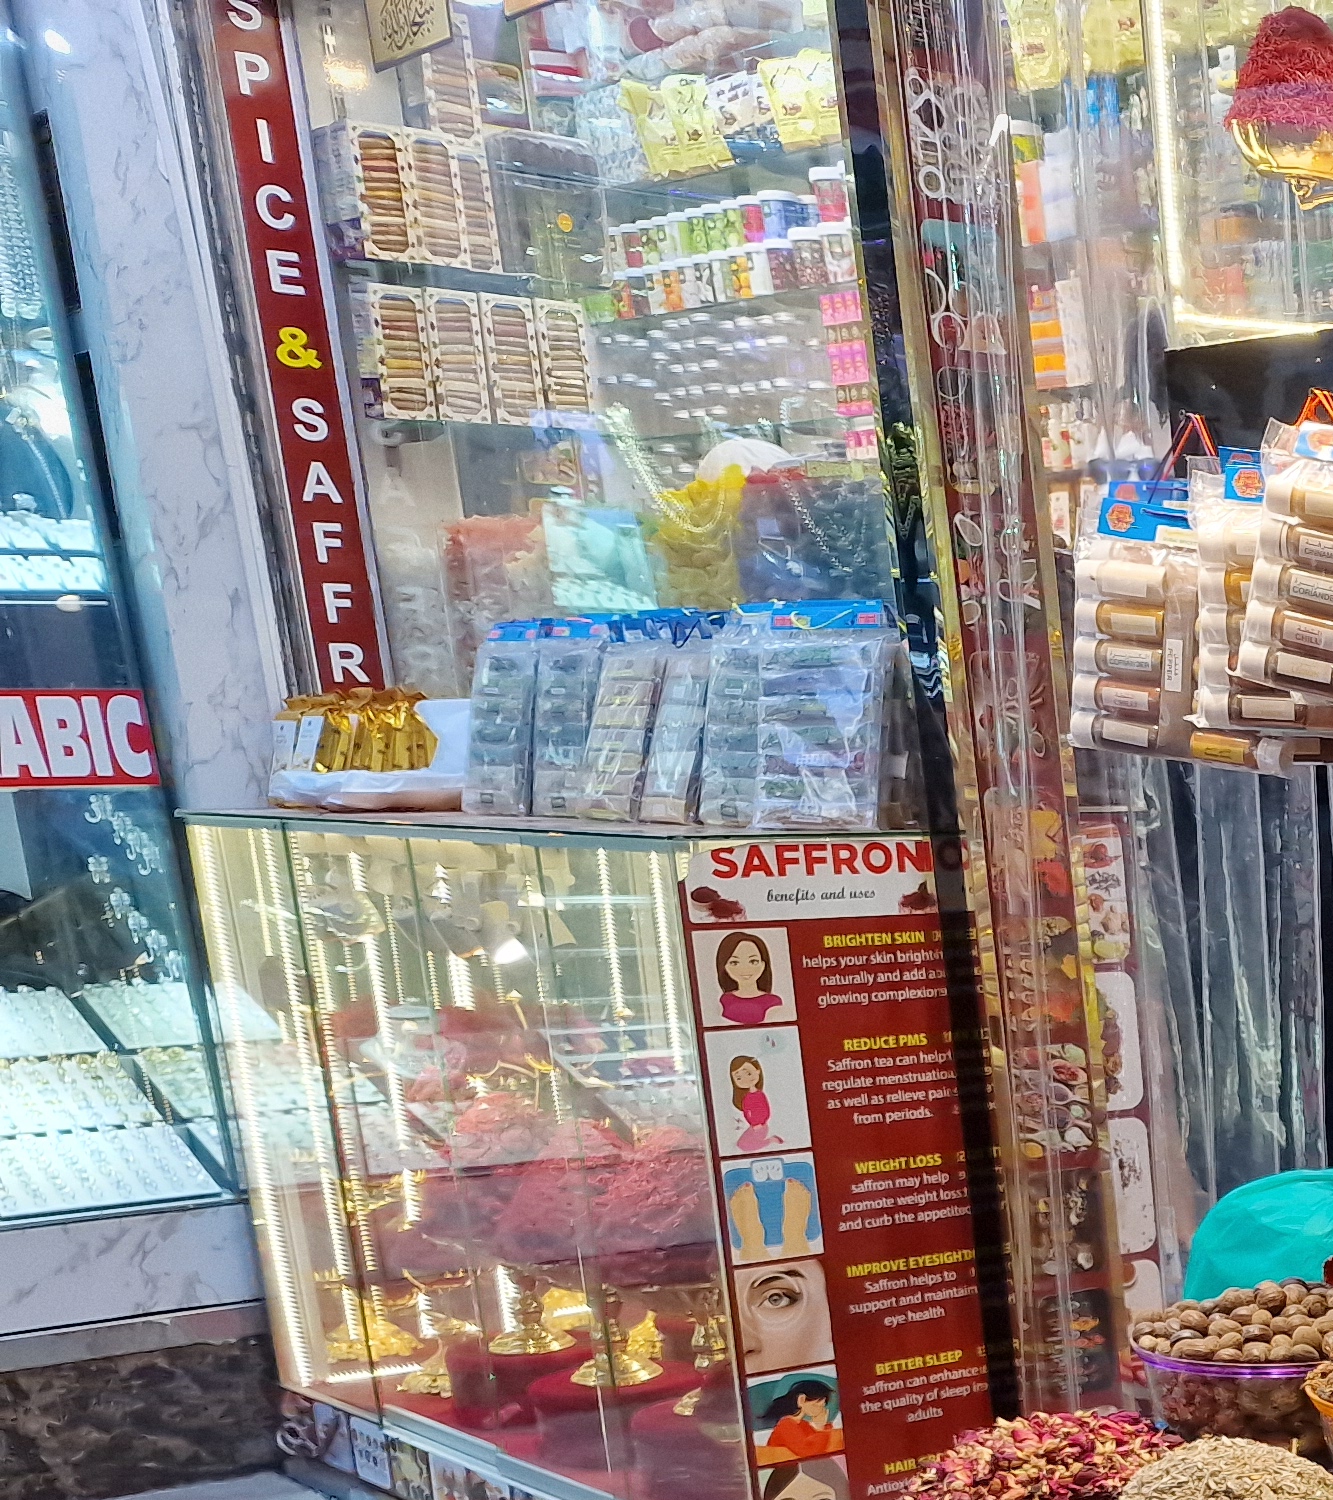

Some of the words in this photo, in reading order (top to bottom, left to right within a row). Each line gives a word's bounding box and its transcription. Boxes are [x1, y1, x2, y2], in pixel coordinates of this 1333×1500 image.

[226, 0, 306, 296] SPICE
[276, 327, 322, 370] &
[711, 842, 930, 879] SAFFRON
[766, 886, 816, 905] benefits
[820, 888, 846, 900] and
[849, 888, 876, 900] uses
[823, 932, 891, 948] BRIGHTEN
[894, 931, 925, 944] SKIN
[801, 955, 838, 970] helps
[839, 956, 869, 969] your
[870, 951, 895, 965] skin
[820, 970, 874, 986] naturally
[877, 970, 901, 983] and
[902, 966, 927, 981] add
[817, 992, 869, 1008] glowing
[843, 1036, 897, 1051] REDUCE
[899, 1033, 928, 1046] PMS
[827, 1058, 872, 1073] Saffron
[874, 1057, 893, 1067] tea
[895, 1055, 917, 1066] can
[919, 1050, 947, 1065] help
[822, 1075, 874, 1092] regulate
[827, 1097, 842, 1109] as
[844, 1094, 868, 1108] well
[870, 1093, 884, 1104] as
[886, 1090, 926, 1103] relieve
[854, 1112, 883, 1125] from
[885, 1106, 934, 1124] periods.
[855, 1157, 908, 1175] WEIGHT
[909, 1154, 942, 1167] LOSS
[852, 1176, 894, 1194] saffron
[895, 1174, 921, 1190] may
[923, 1171, 949, 1185] help
[841, 1196, 896, 1215] promote
[897, 1190, 938, 1207] weight
[839, 1220, 862, 1232] and
[864, 1215, 893, 1228] curb
[895, 1212, 915, 1223] the
[847, 1259, 908, 1278] IMPROVE
[864, 1277, 909, 1294] Saffron
[909, 1271, 943, 1286] helps
[943, 1270, 957, 1281] to
[848, 1296, 898, 1314] support
[899, 1293, 922, 1305] and
[884, 1314, 907, 1328] eye
[907, 1306, 946, 1321] health
[875, 1356, 925, 1376] BETTER
[925, 1350, 962, 1366] SLEEP
[862, 1378, 904, 1396] saffron
[906, 1374, 928, 1388] can
[929, 1367, 980, 1384] enhance
[860, 1399, 882, 1414] the
[883, 1392, 925, 1411] quality
[926, 1387, 940, 1402] of
[940, 1384, 971, 1400] sleep
[906, 1407, 944, 1423] adults
[884, 1458, 917, 1476] HAIR
